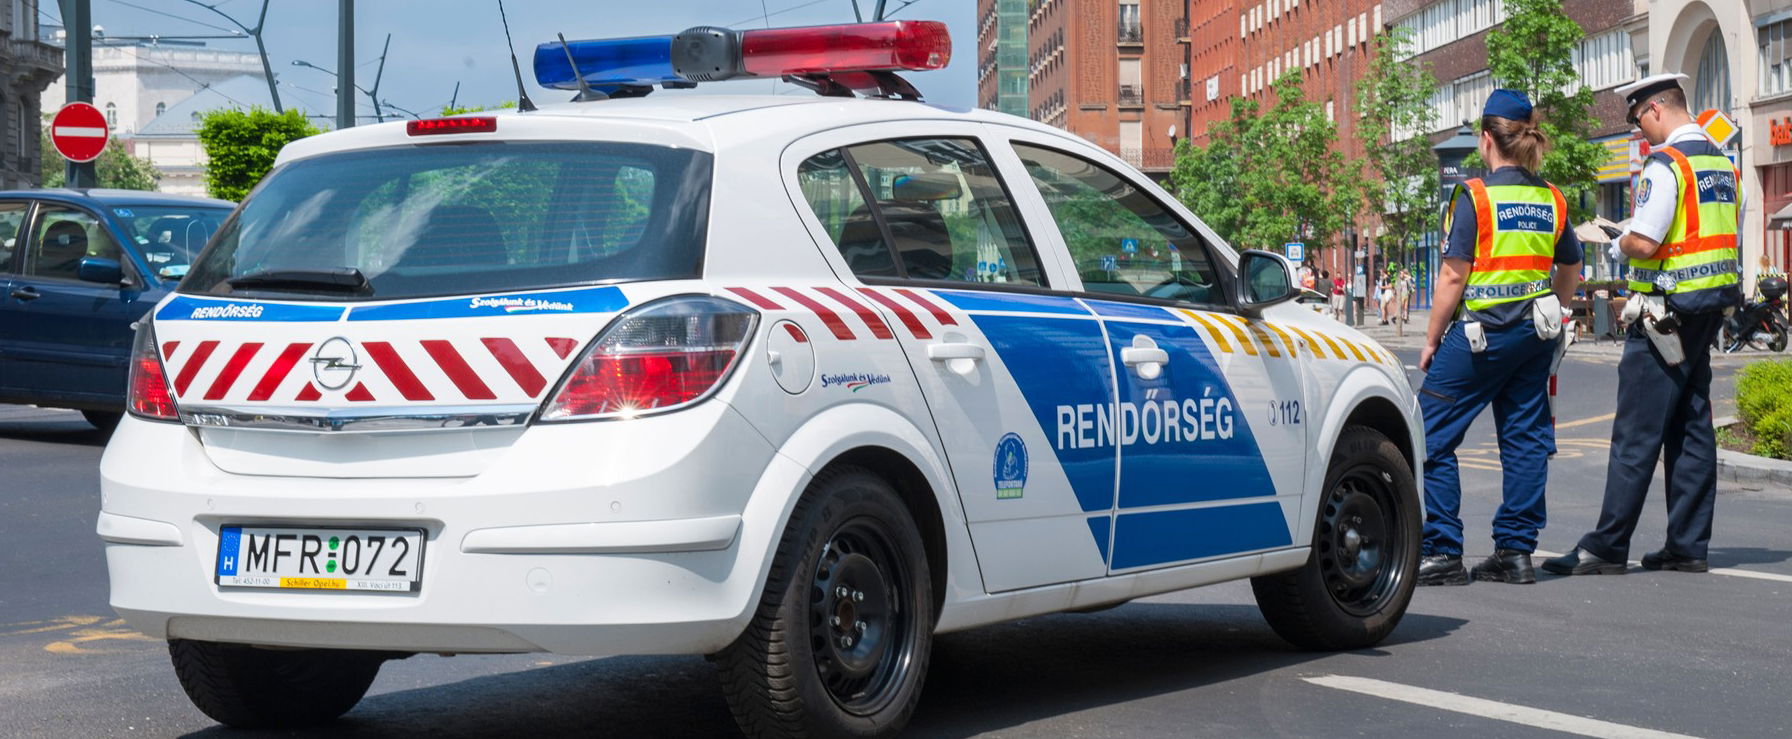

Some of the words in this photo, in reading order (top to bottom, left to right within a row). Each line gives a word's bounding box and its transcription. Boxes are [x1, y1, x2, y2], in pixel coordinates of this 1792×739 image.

[1498, 203, 1553, 224] RENDŐRSÉG
[1518, 221, 1537, 229] POLICE
[1690, 261, 1736, 276] POLIC
[1476, 284, 1526, 297] POLICE
[191, 303, 263, 319] RENDŐRSÉG
[1056, 387, 1233, 450] RENDŐRSÉG
[1279, 400, 1300, 425] 112
[223, 556, 234, 570] H
